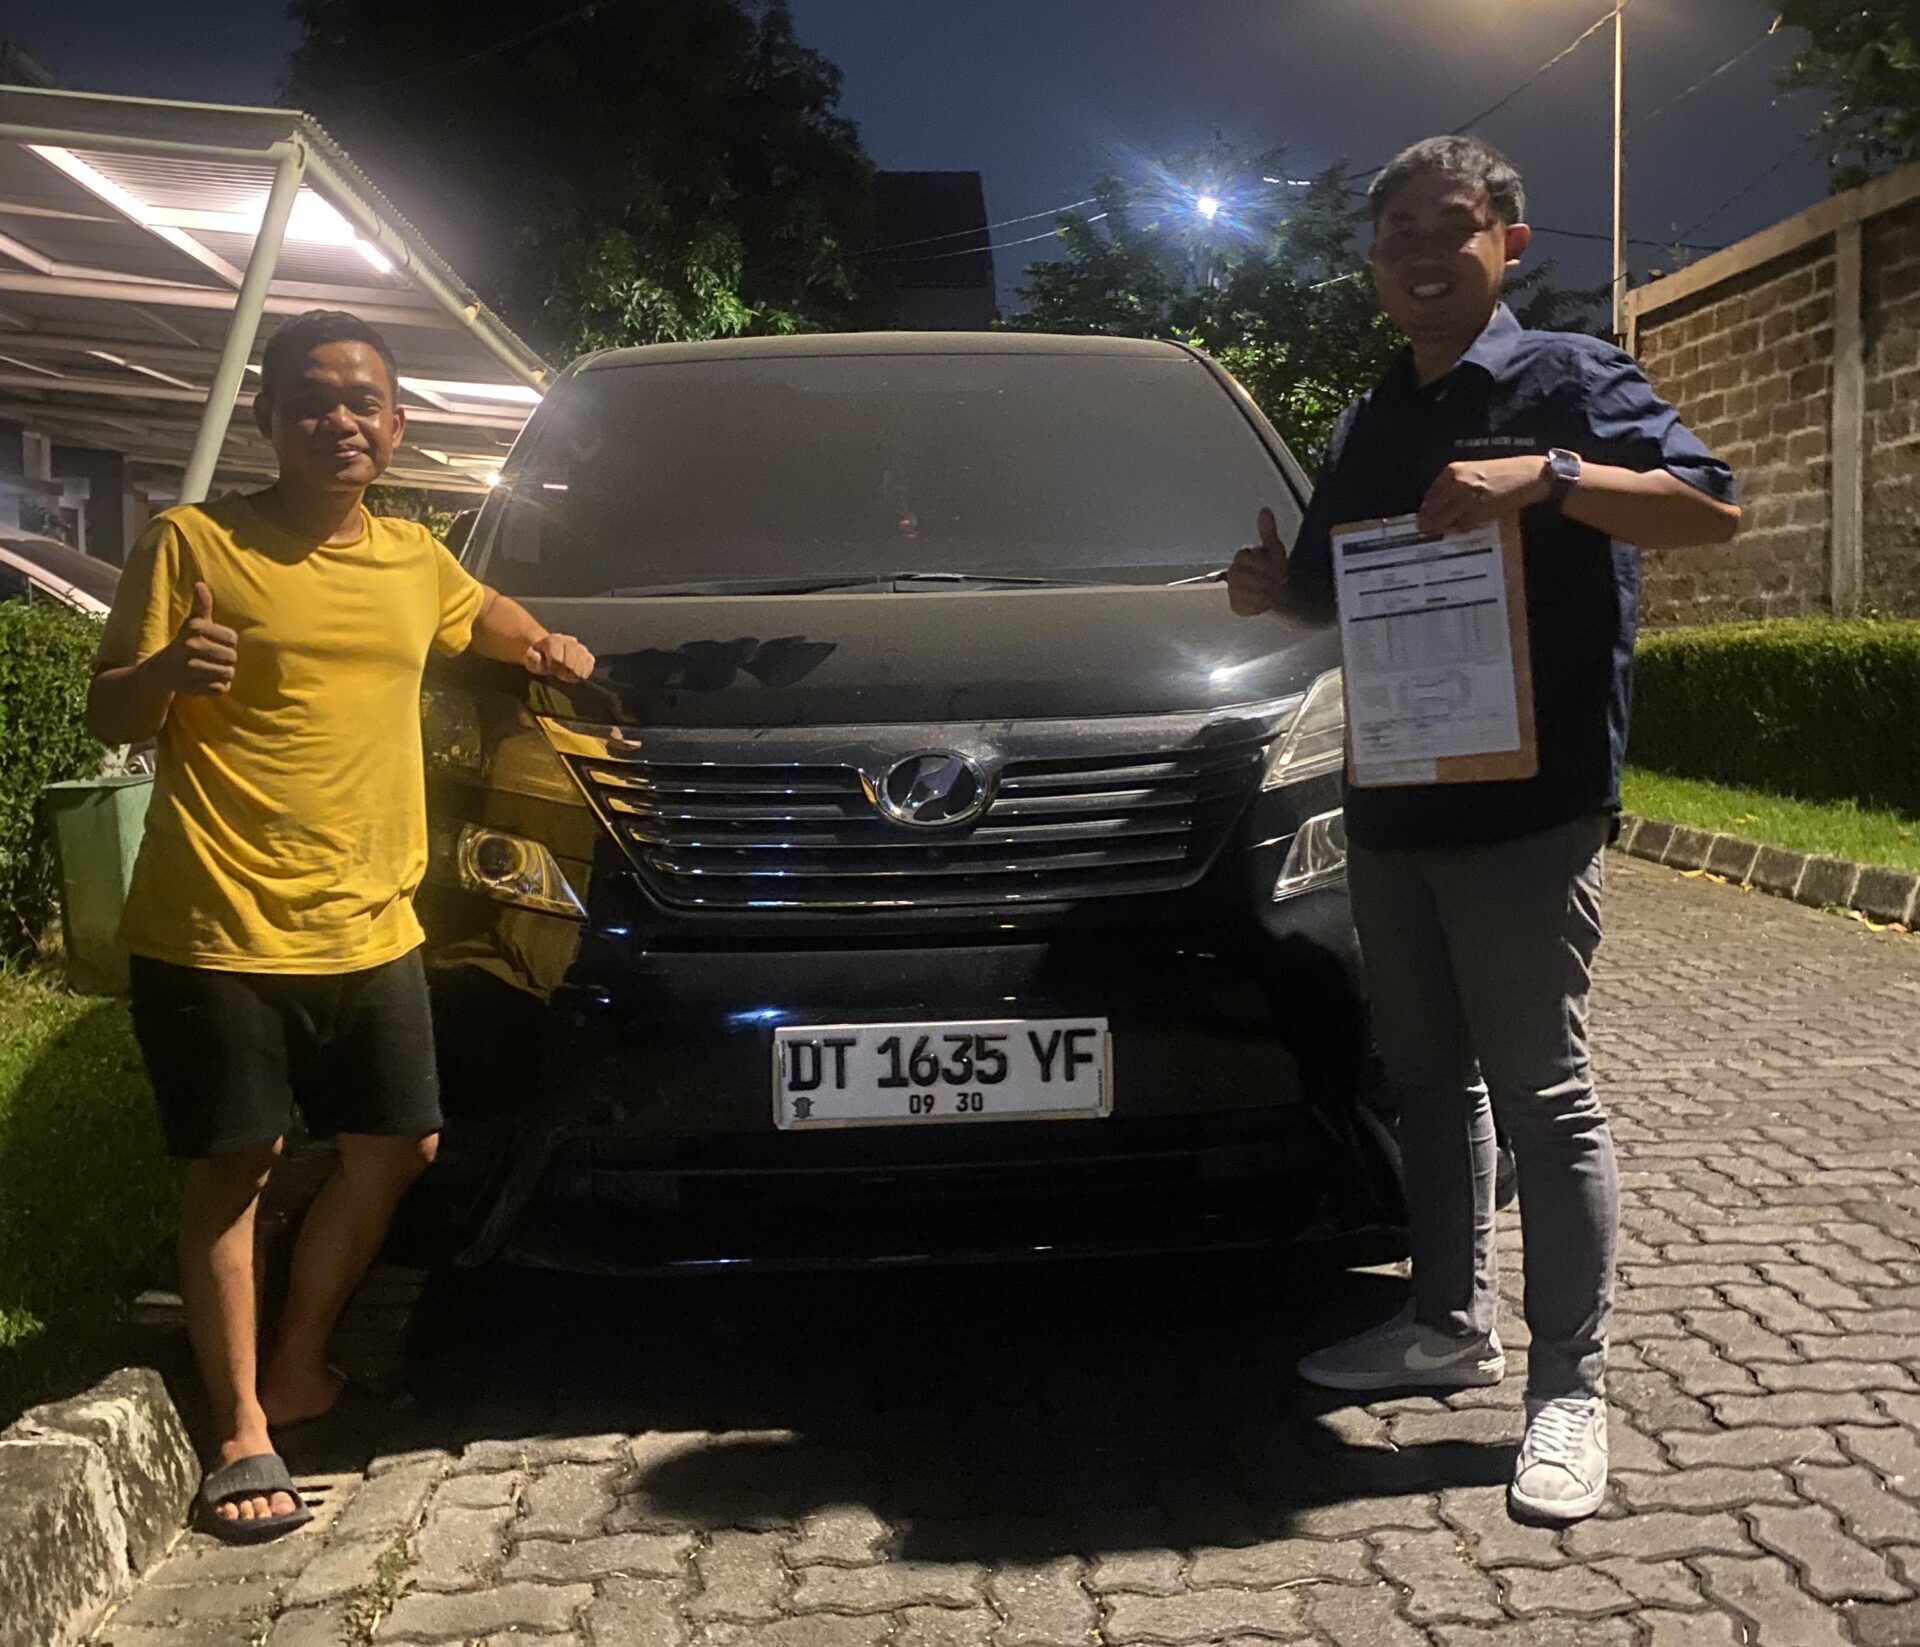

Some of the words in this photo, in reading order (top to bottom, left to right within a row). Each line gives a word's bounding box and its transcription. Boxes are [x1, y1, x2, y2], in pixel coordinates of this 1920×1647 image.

[788, 1038, 856, 1091] DT
[877, 1034, 1007, 1087] 1635
[1027, 1028, 1096, 1082] YF
[909, 1094, 935, 1113] 09
[956, 1092, 983, 1111] 30
